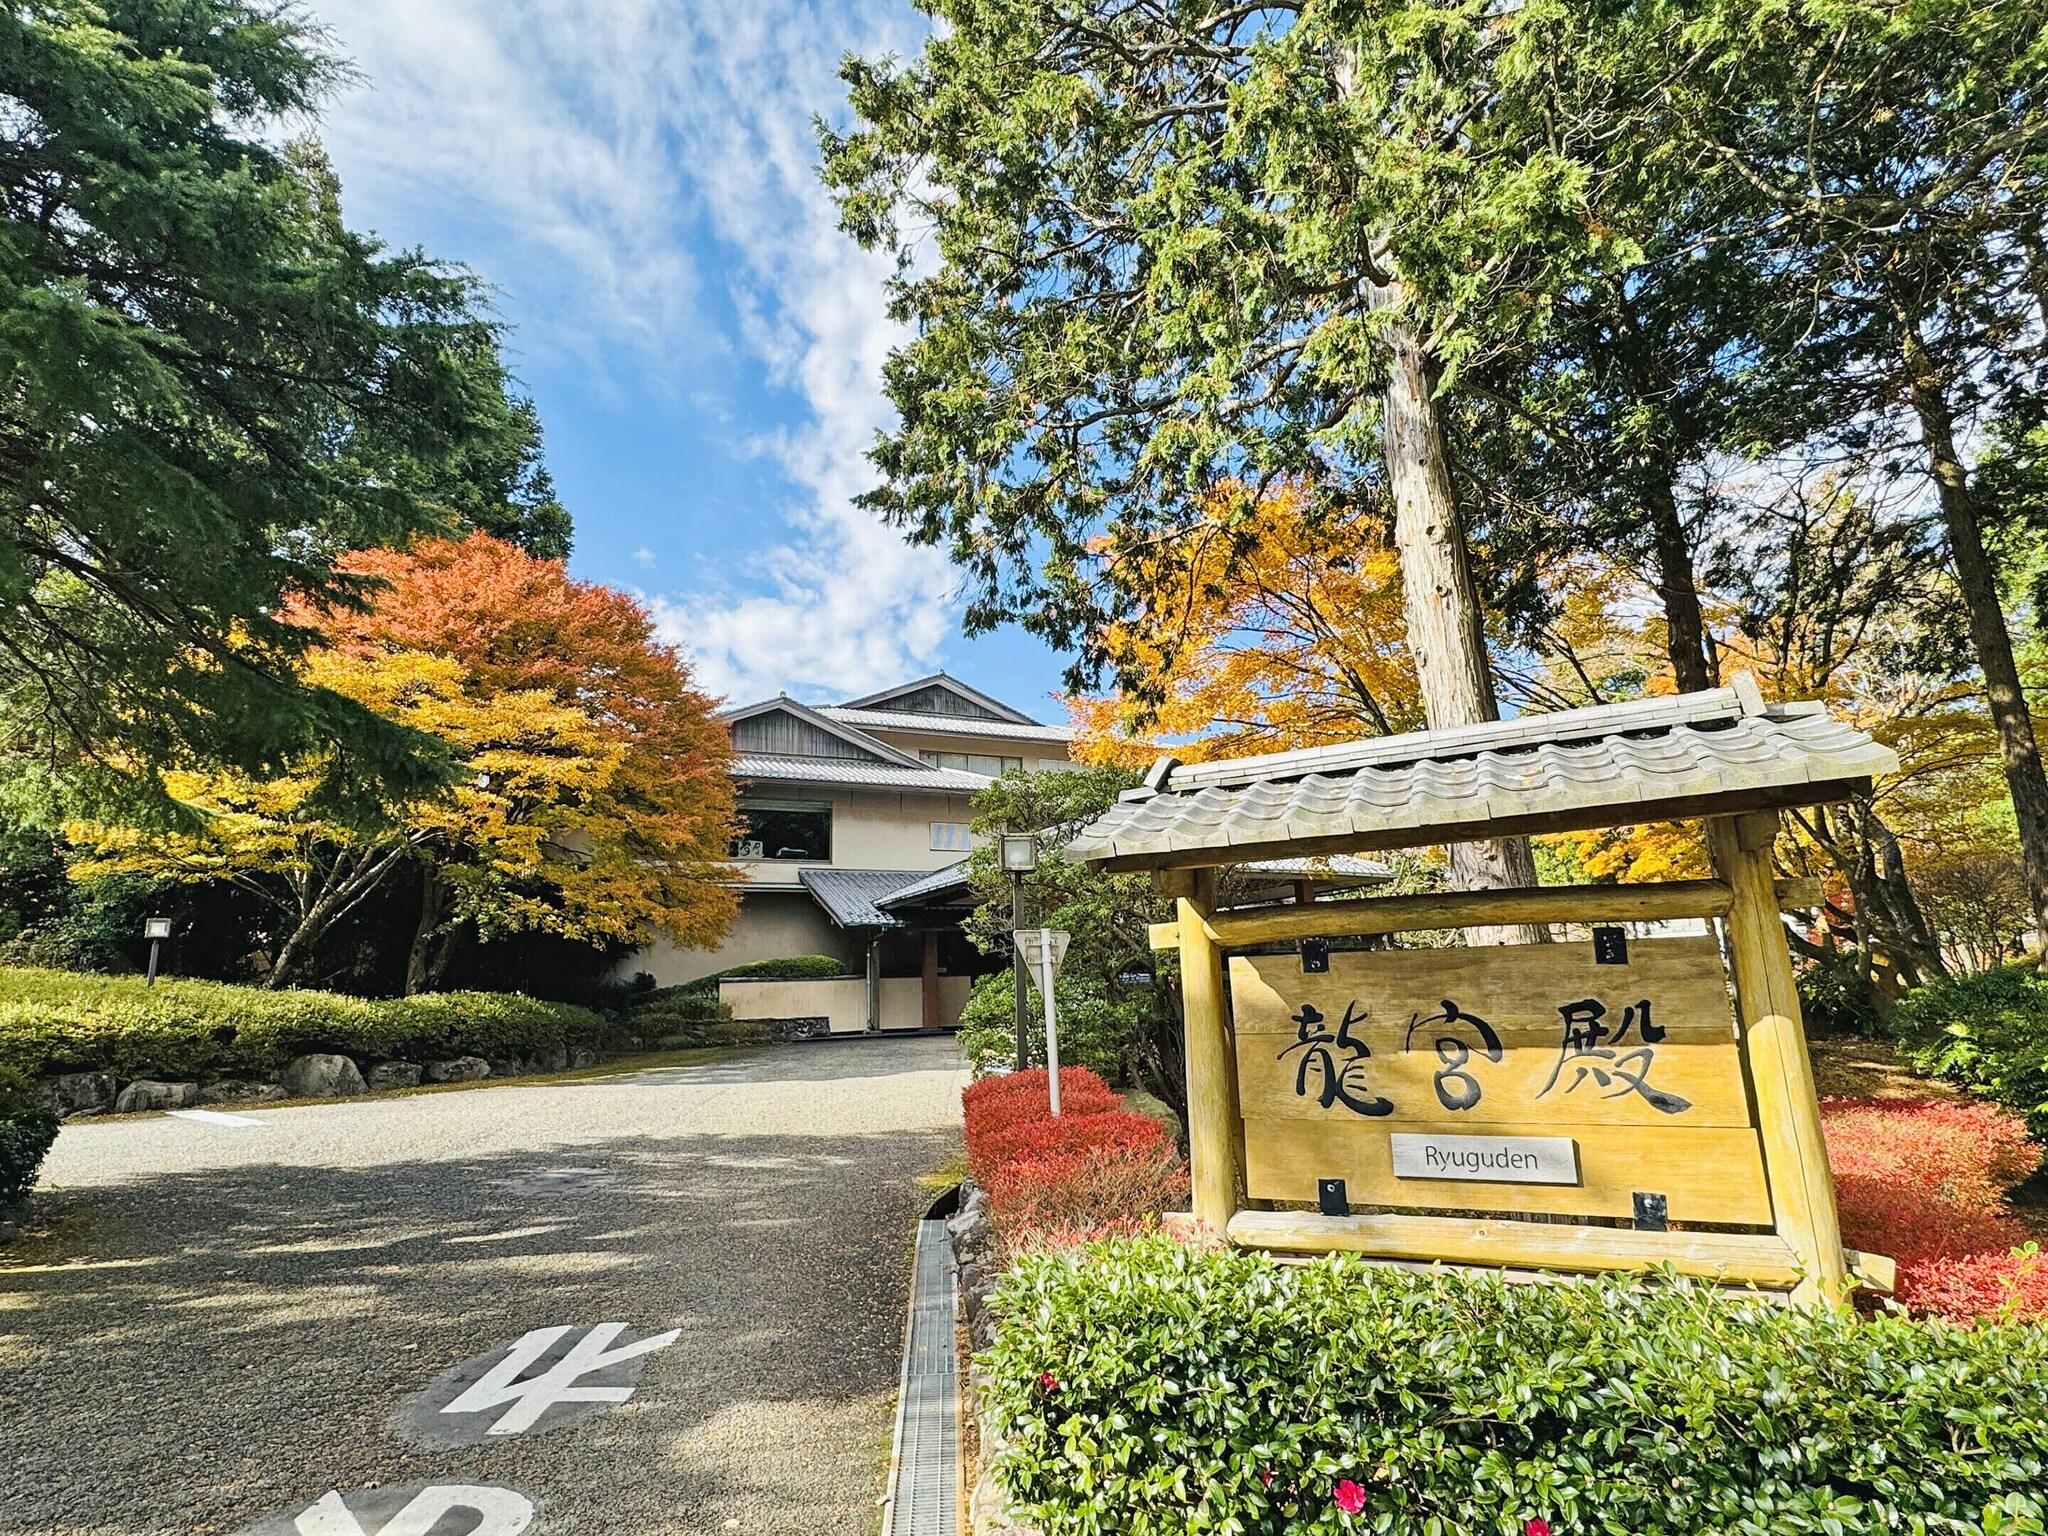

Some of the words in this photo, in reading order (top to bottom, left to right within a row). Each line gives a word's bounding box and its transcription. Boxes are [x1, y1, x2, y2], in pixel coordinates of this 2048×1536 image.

[1277, 999, 1692, 1116] 龍宮殿
[1425, 1145, 1538, 1173] Ryuguden
